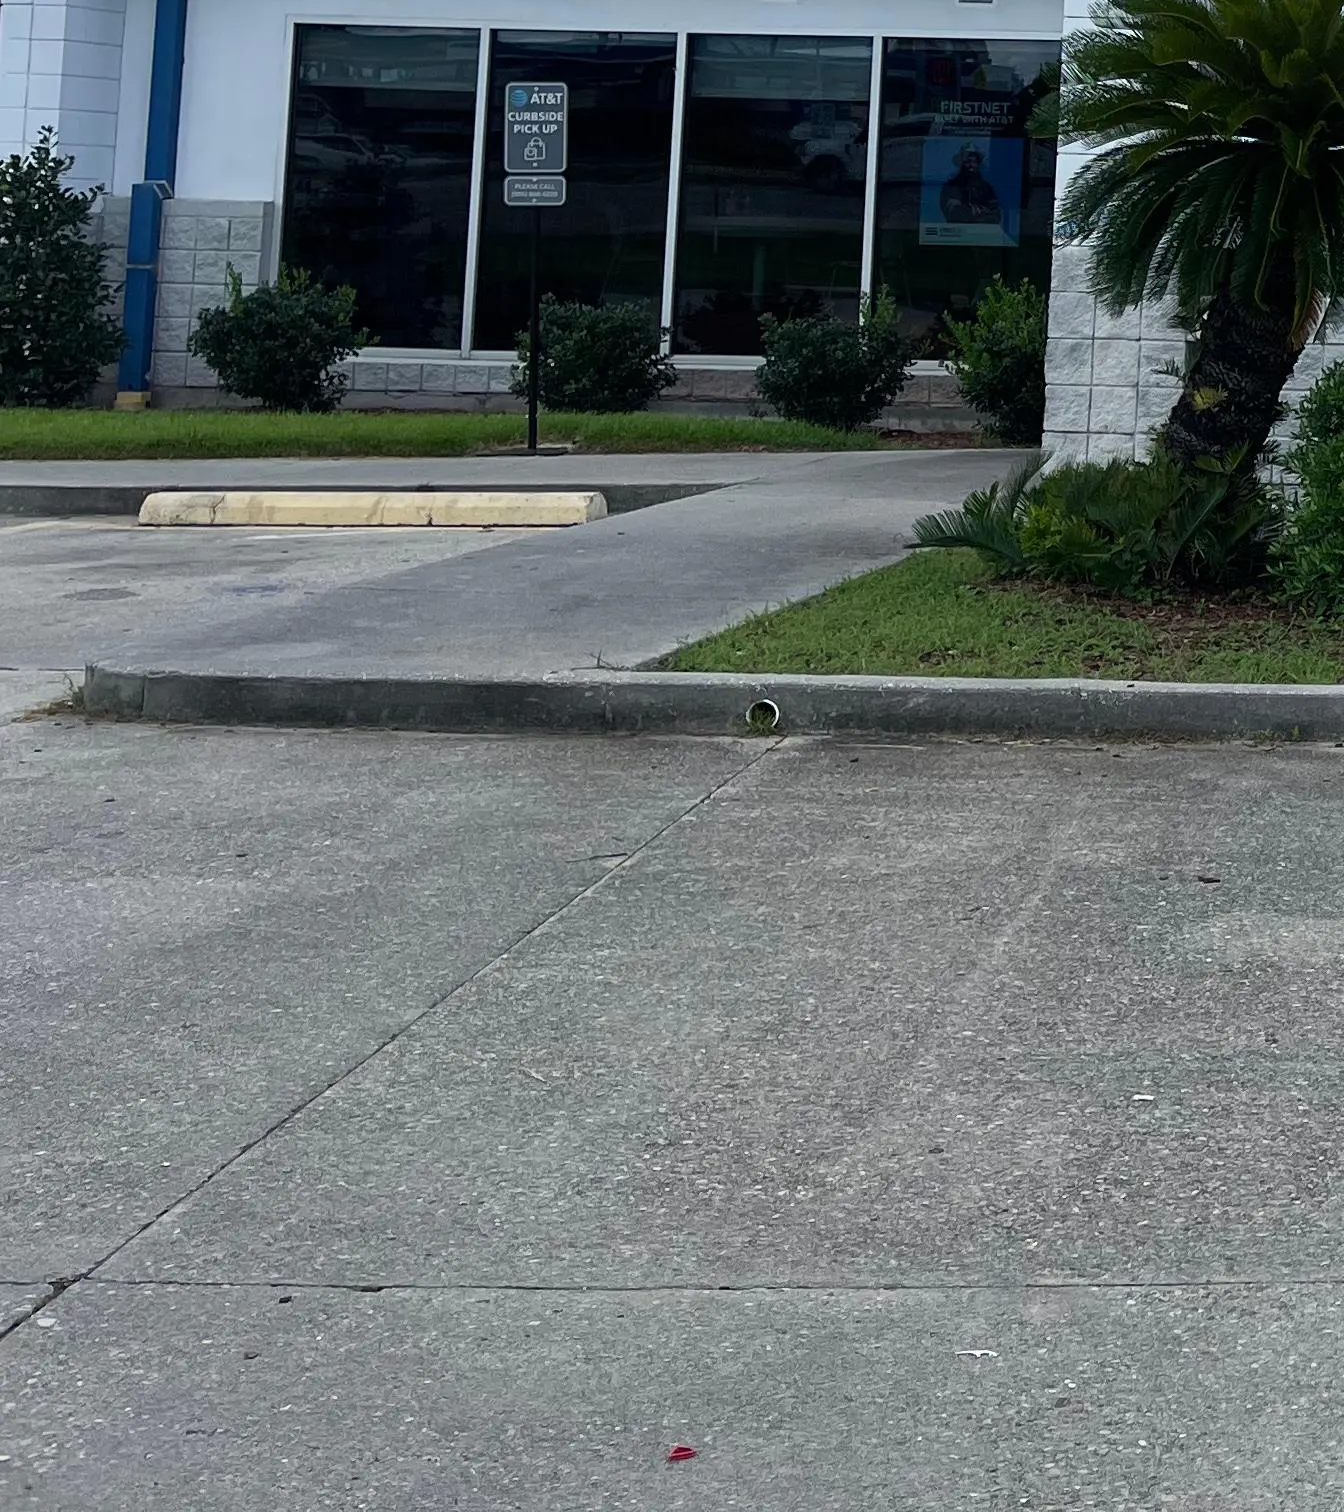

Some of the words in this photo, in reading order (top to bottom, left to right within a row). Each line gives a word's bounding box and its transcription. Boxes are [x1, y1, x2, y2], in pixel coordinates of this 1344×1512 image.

[530, 92, 564, 105] AT&T
[940, 100, 1012, 114] FIRSTNET
[508, 111, 564, 122] CURBSIDE
[513, 124, 540, 134] PICK
[542, 124, 558, 134] UP
